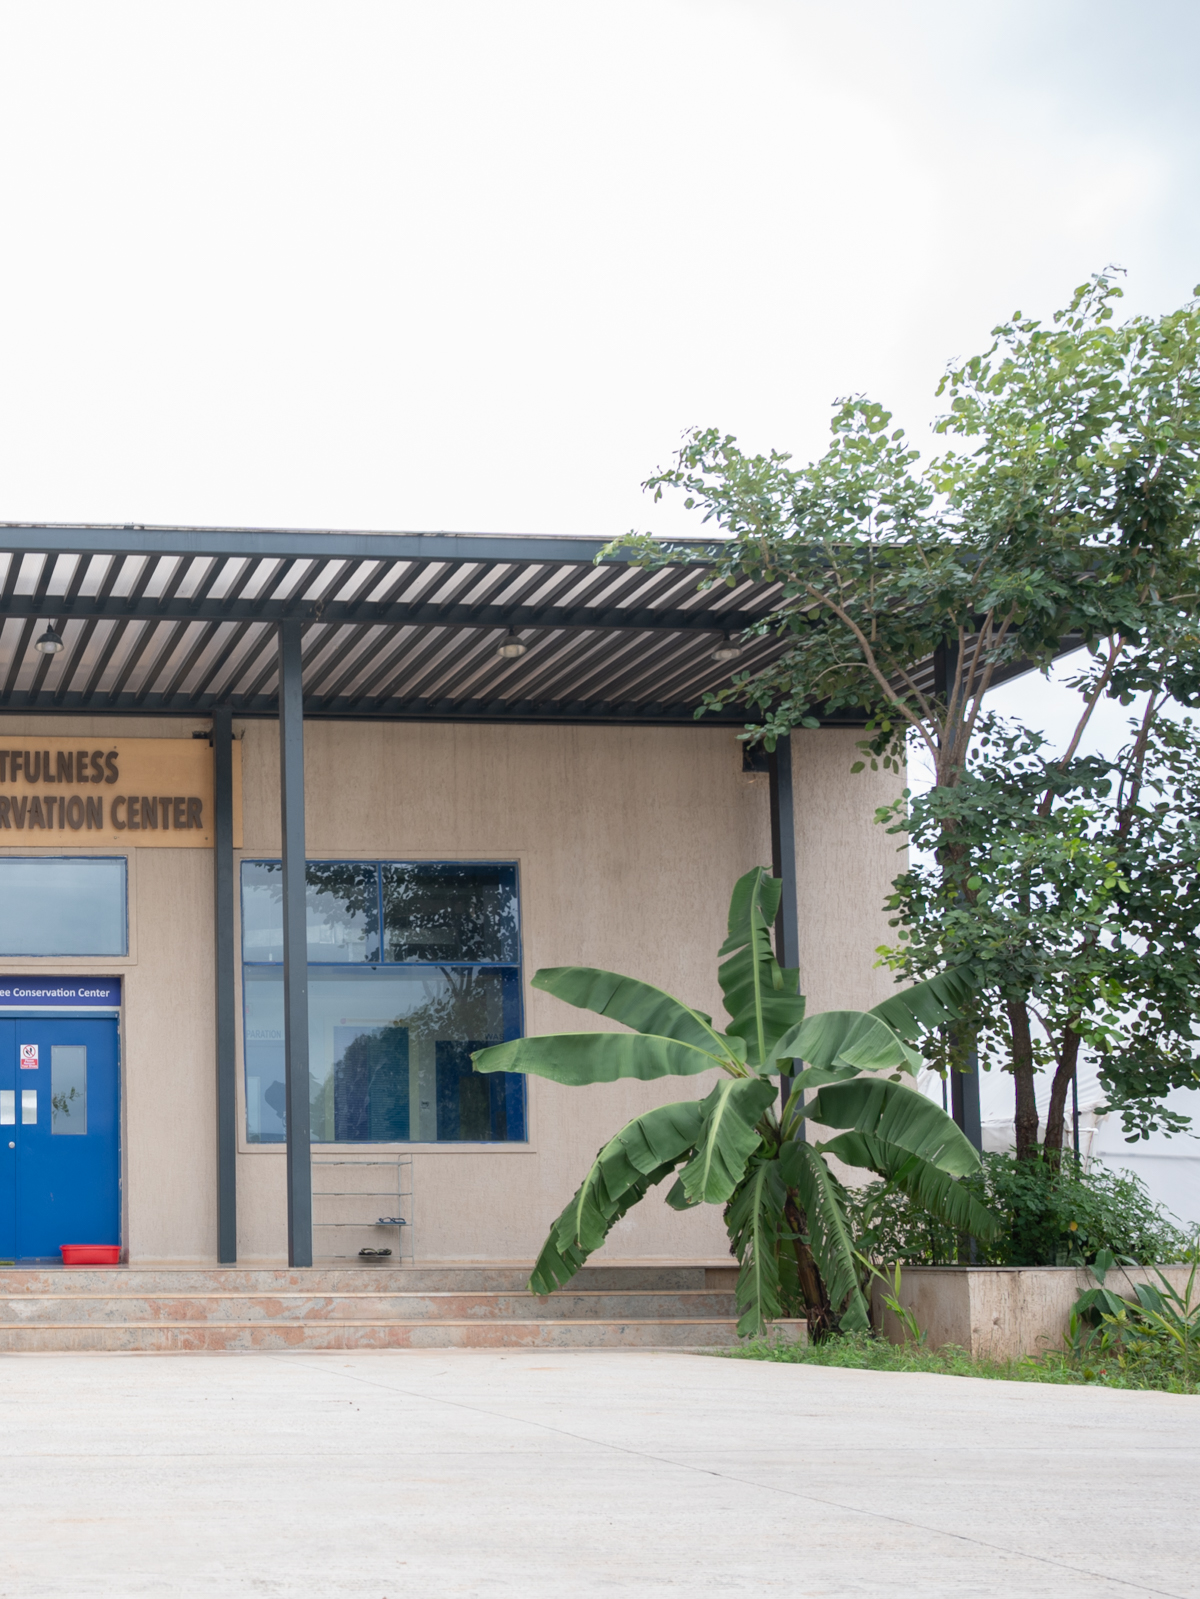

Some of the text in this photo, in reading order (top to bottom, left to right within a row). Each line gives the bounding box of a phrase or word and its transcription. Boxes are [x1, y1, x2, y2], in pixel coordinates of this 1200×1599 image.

[110, 796, 204, 830] CENTER
[12, 987, 76, 997] Conservation
[78, 988, 110, 997] Center
